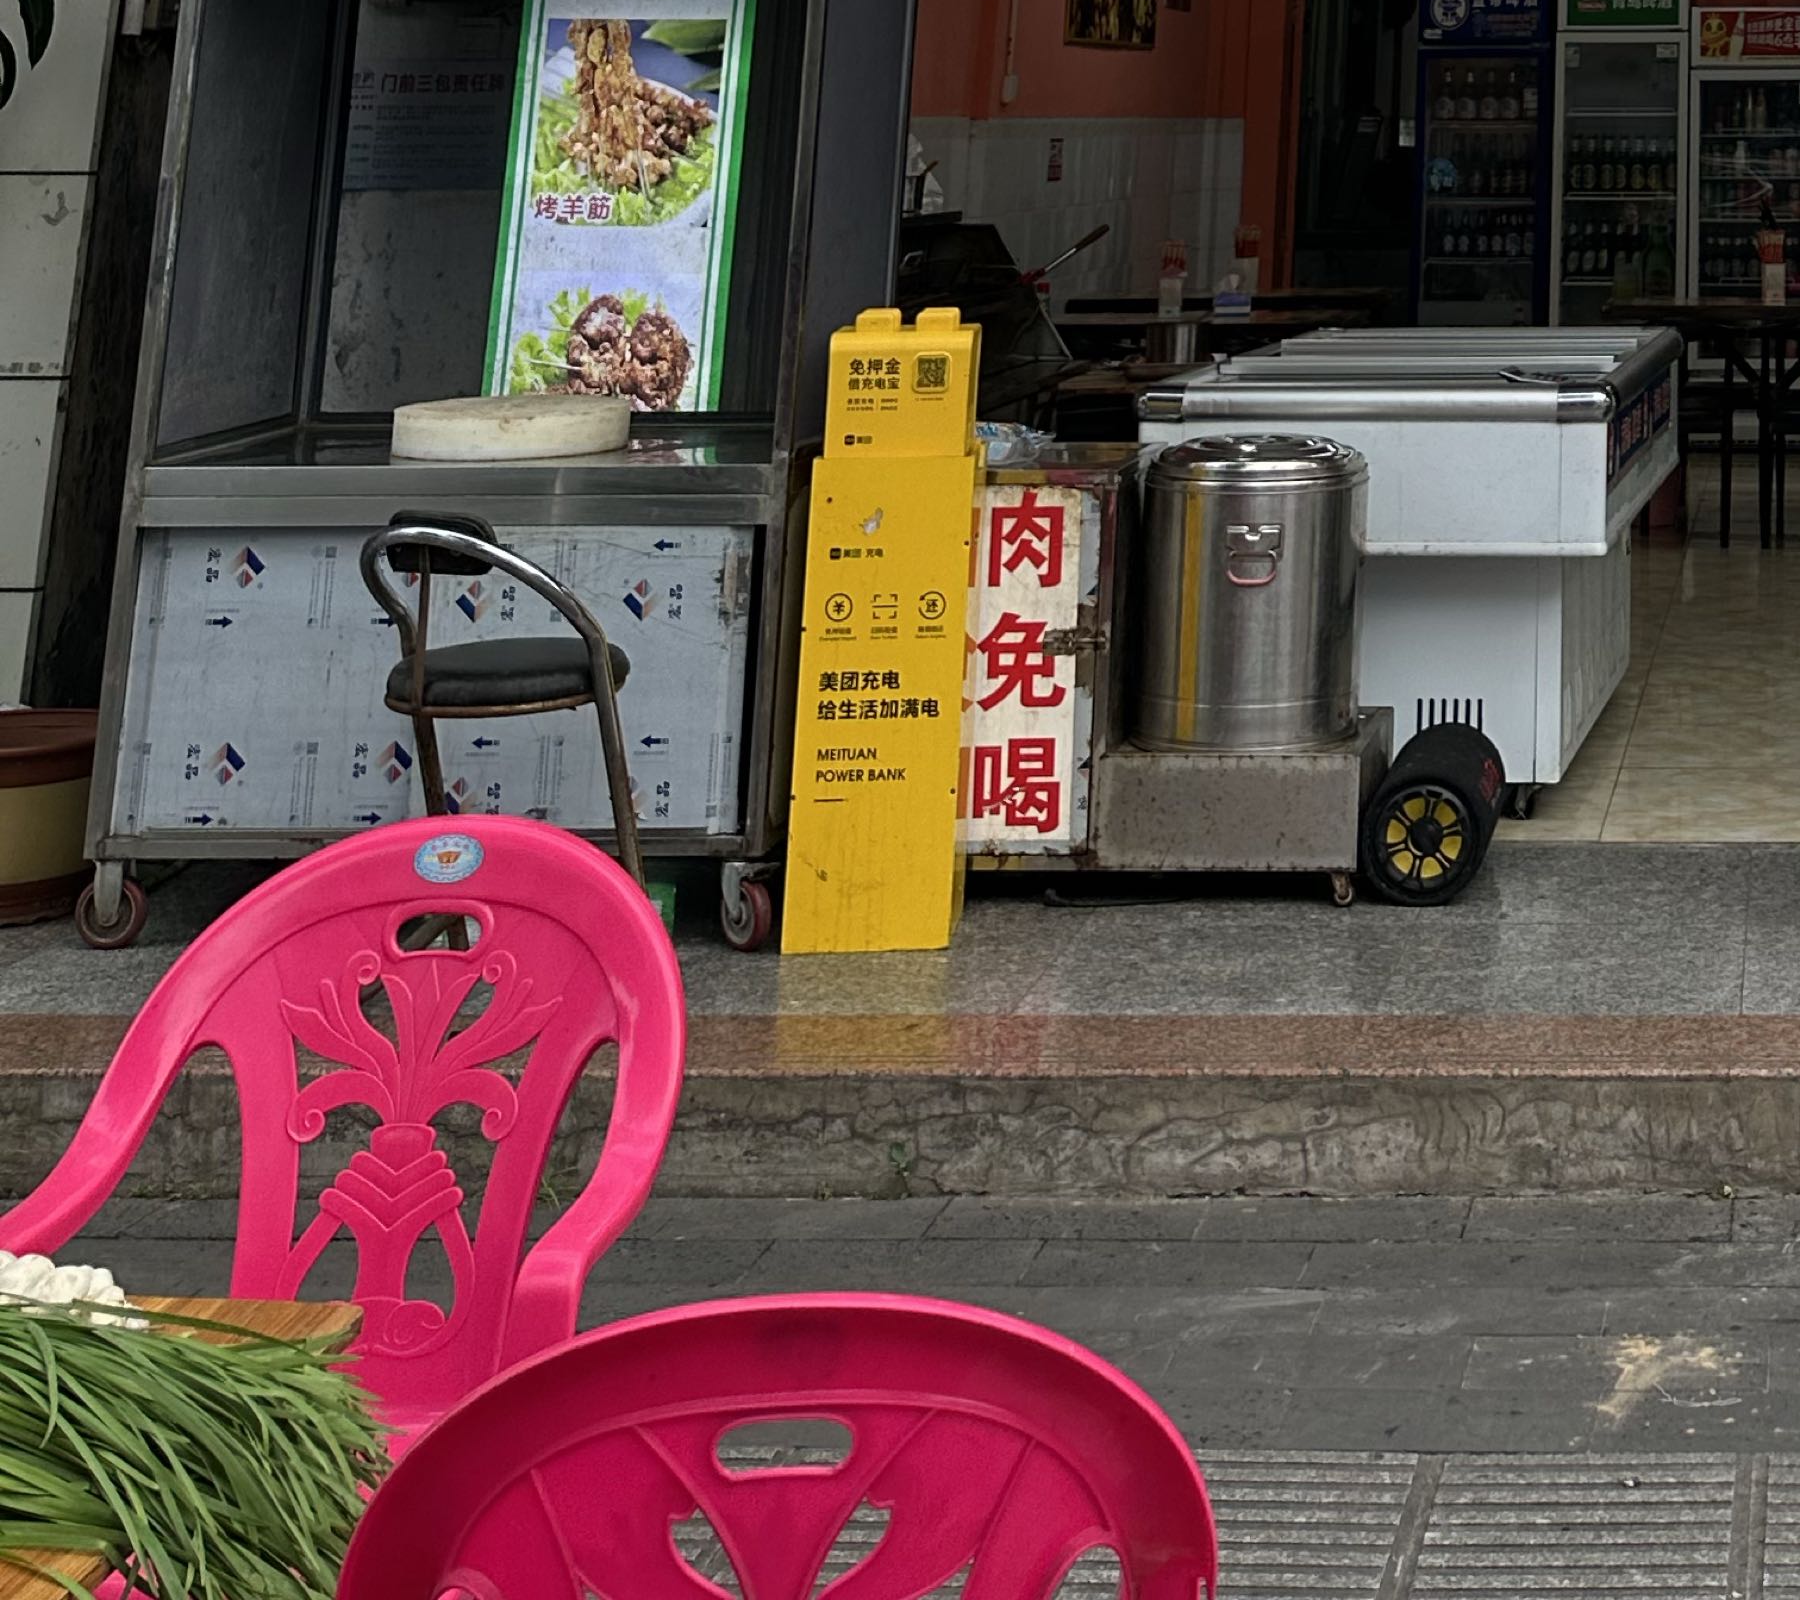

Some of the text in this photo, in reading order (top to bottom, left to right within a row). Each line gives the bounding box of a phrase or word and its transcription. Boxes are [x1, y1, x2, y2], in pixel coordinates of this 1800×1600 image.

[533, 192, 613, 223] 烤羊筋
[848, 357, 902, 376] 免押金
[818, 670, 901, 692] 美团充电
[816, 697, 940, 720] 给生活加满电
[816, 747, 878, 762] MEITUAN
[815, 767, 907, 783] POWER BANK
